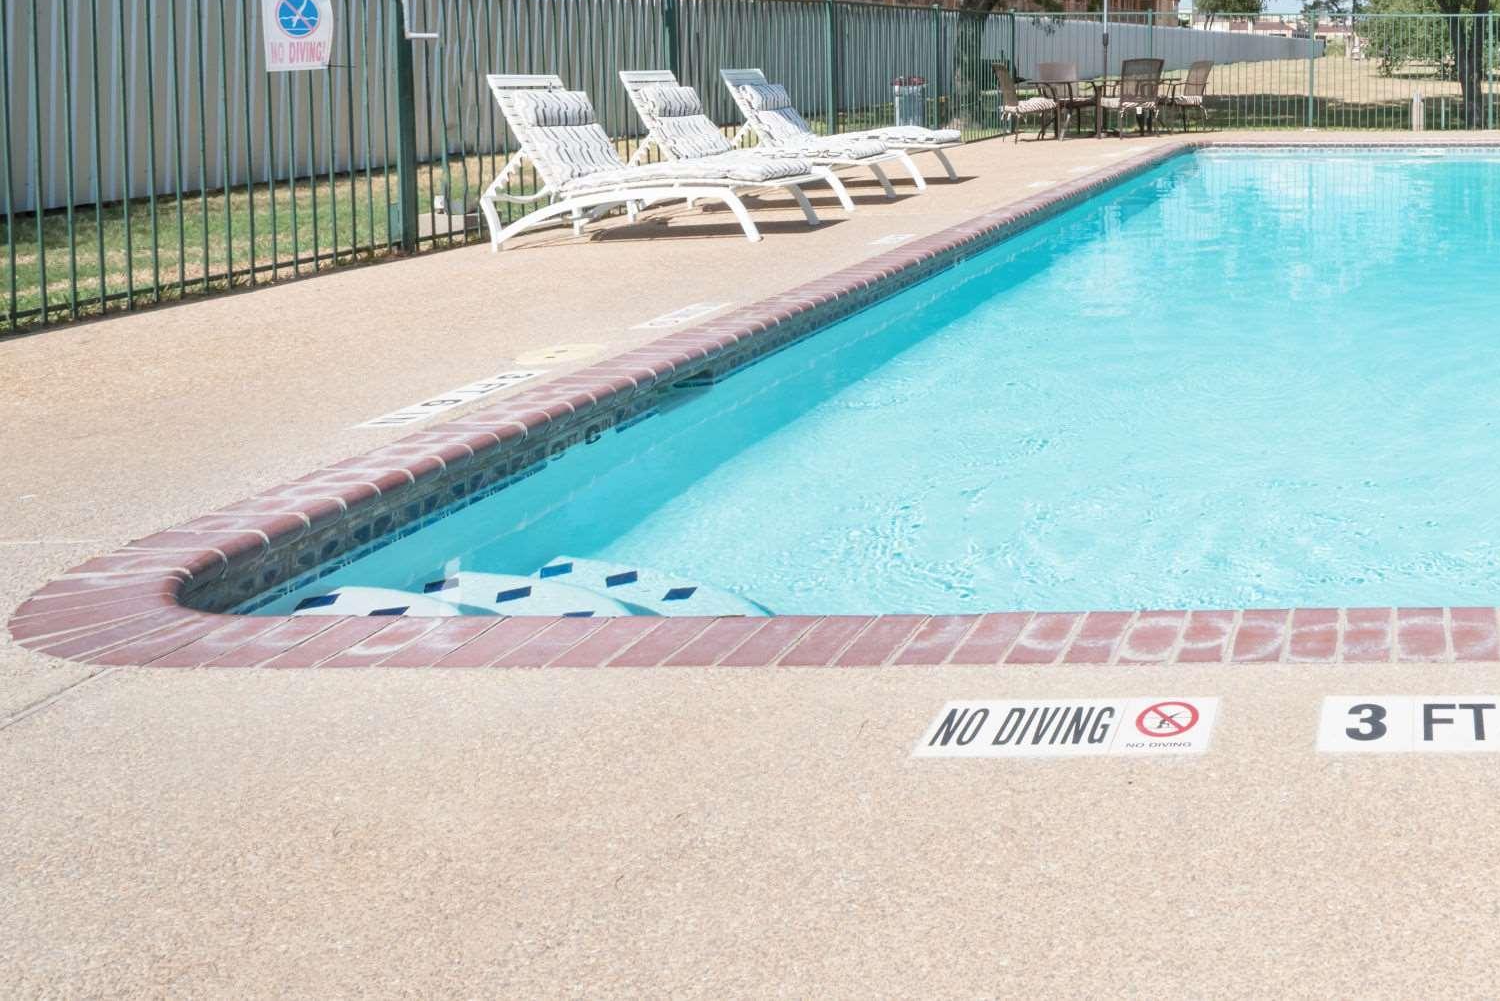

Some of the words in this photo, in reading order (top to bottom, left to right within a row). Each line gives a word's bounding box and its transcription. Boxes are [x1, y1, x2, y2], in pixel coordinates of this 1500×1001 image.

[270, 42, 285, 63] NO
[928, 708, 991, 746] NO
[991, 706, 1116, 746] DIVING
[1345, 703, 1387, 741] 3
[1423, 703, 1497, 741] FT
